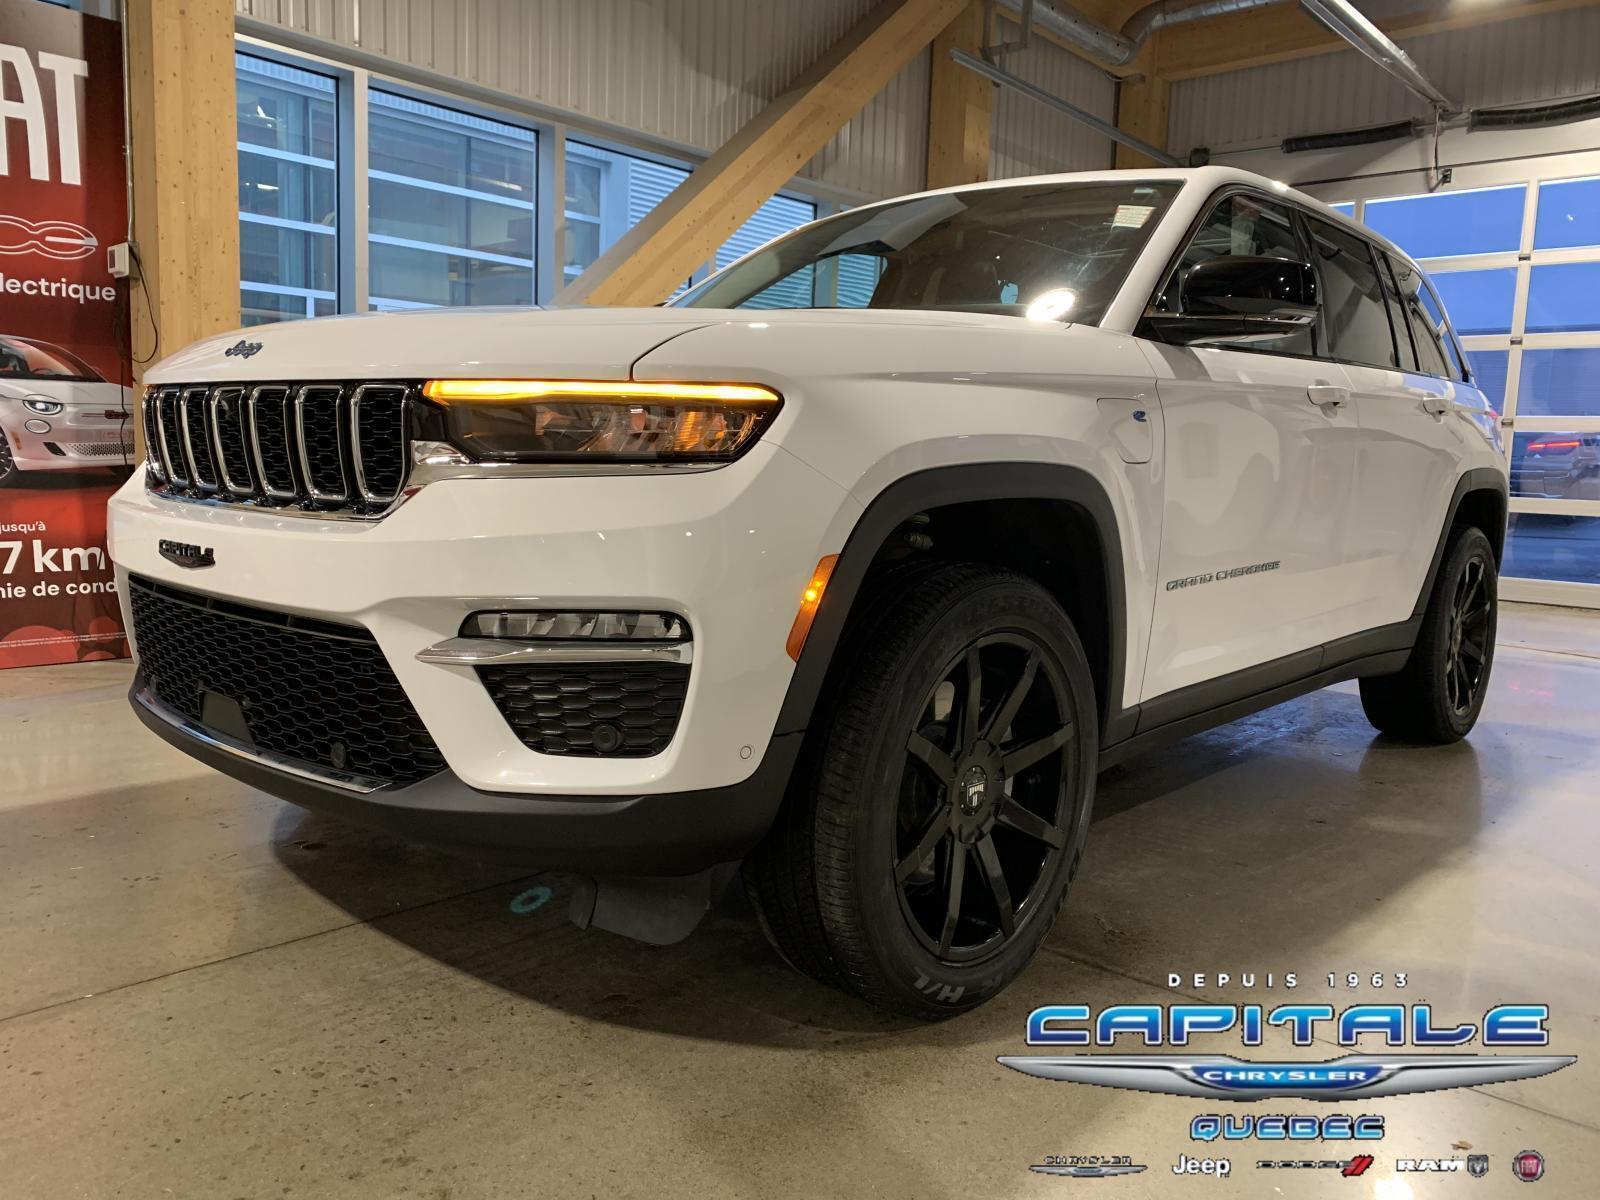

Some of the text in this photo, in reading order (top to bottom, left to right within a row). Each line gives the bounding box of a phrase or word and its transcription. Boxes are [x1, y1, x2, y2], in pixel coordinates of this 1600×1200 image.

[33, 539, 106, 573] km
[158, 539, 214, 561] CAPITALE
[32, 580, 60, 597] de
[1166, 560, 1281, 591] GRAND CHEROKEE
